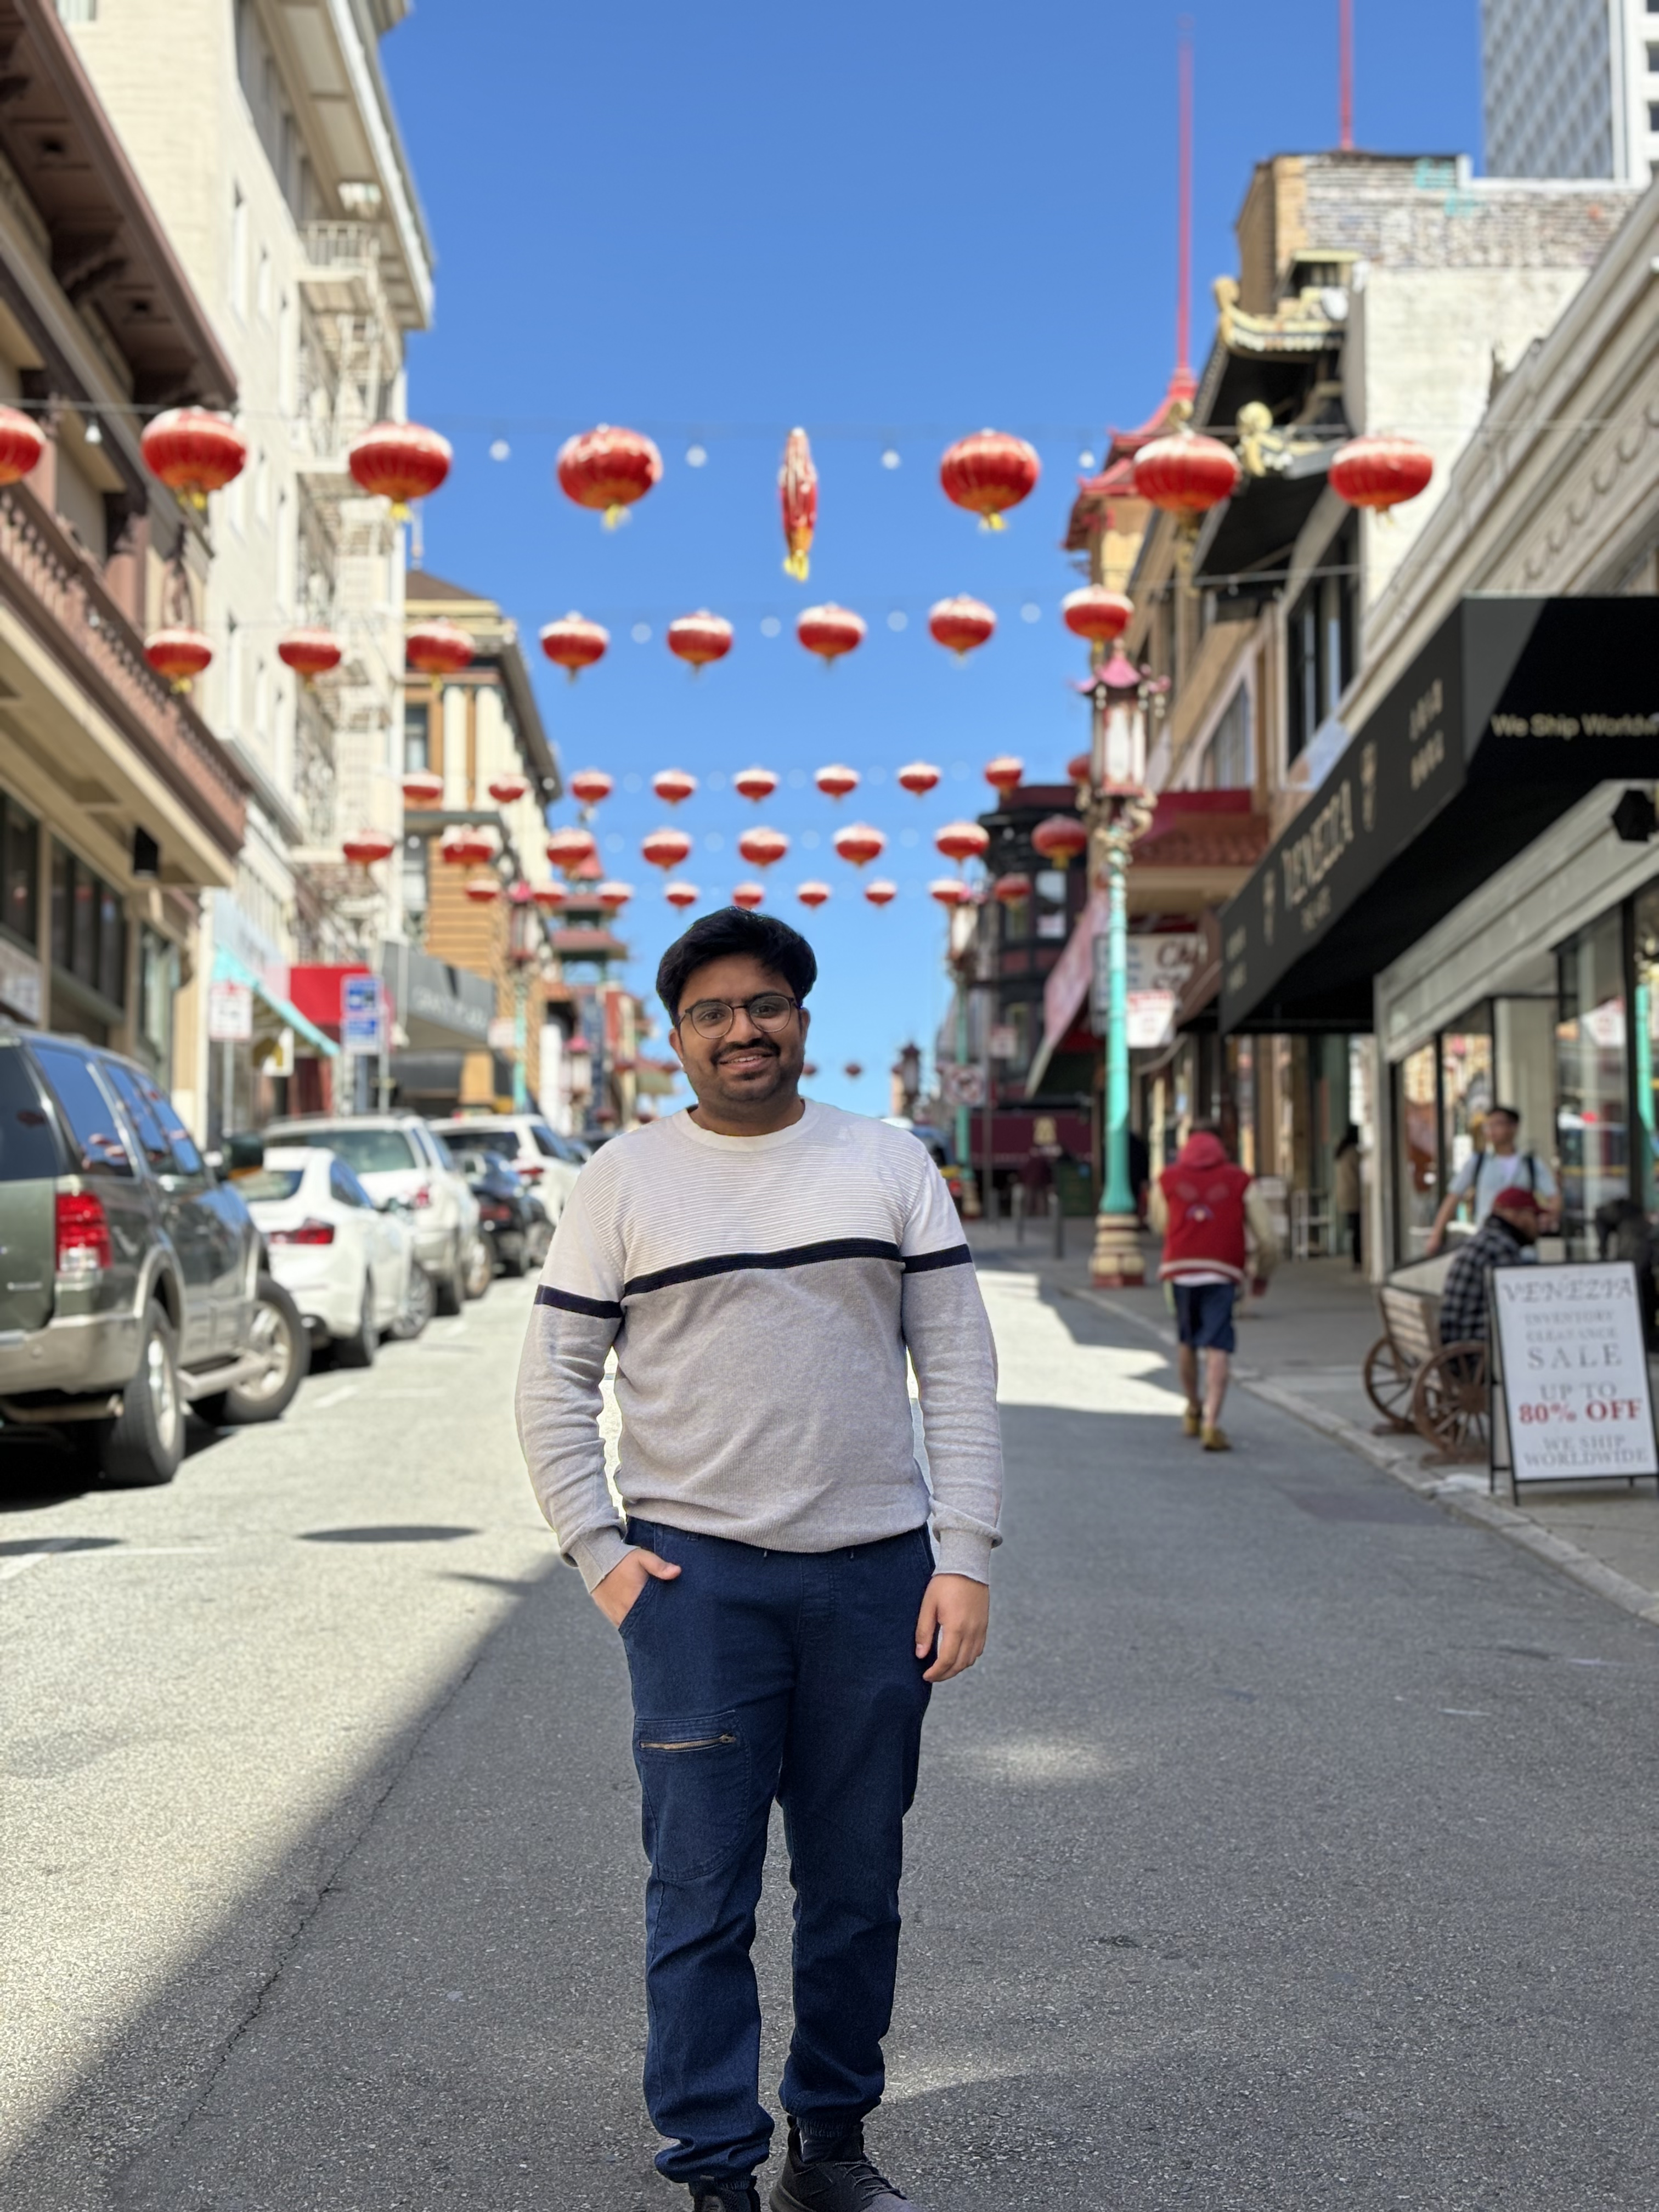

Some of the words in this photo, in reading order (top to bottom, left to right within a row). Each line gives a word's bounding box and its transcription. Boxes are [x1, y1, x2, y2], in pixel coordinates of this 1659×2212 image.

[1491, 714, 1529, 737] We
[1530, 713, 1581, 741] Ship
[1503, 1277, 1632, 1301] VENEZIA
[1528, 1344, 1621, 1369] SALE
[1541, 1384, 1572, 1400] UP
[1580, 1381, 1616, 1398] TO
[1520, 1402, 1576, 1423] 80%
[1587, 1399, 1642, 1421] OFF
[1543, 1437, 1571, 1449] WE
[1581, 1435, 1624, 1449] SHIP
[1525, 1449, 1647, 1466] WORLDWIDE
